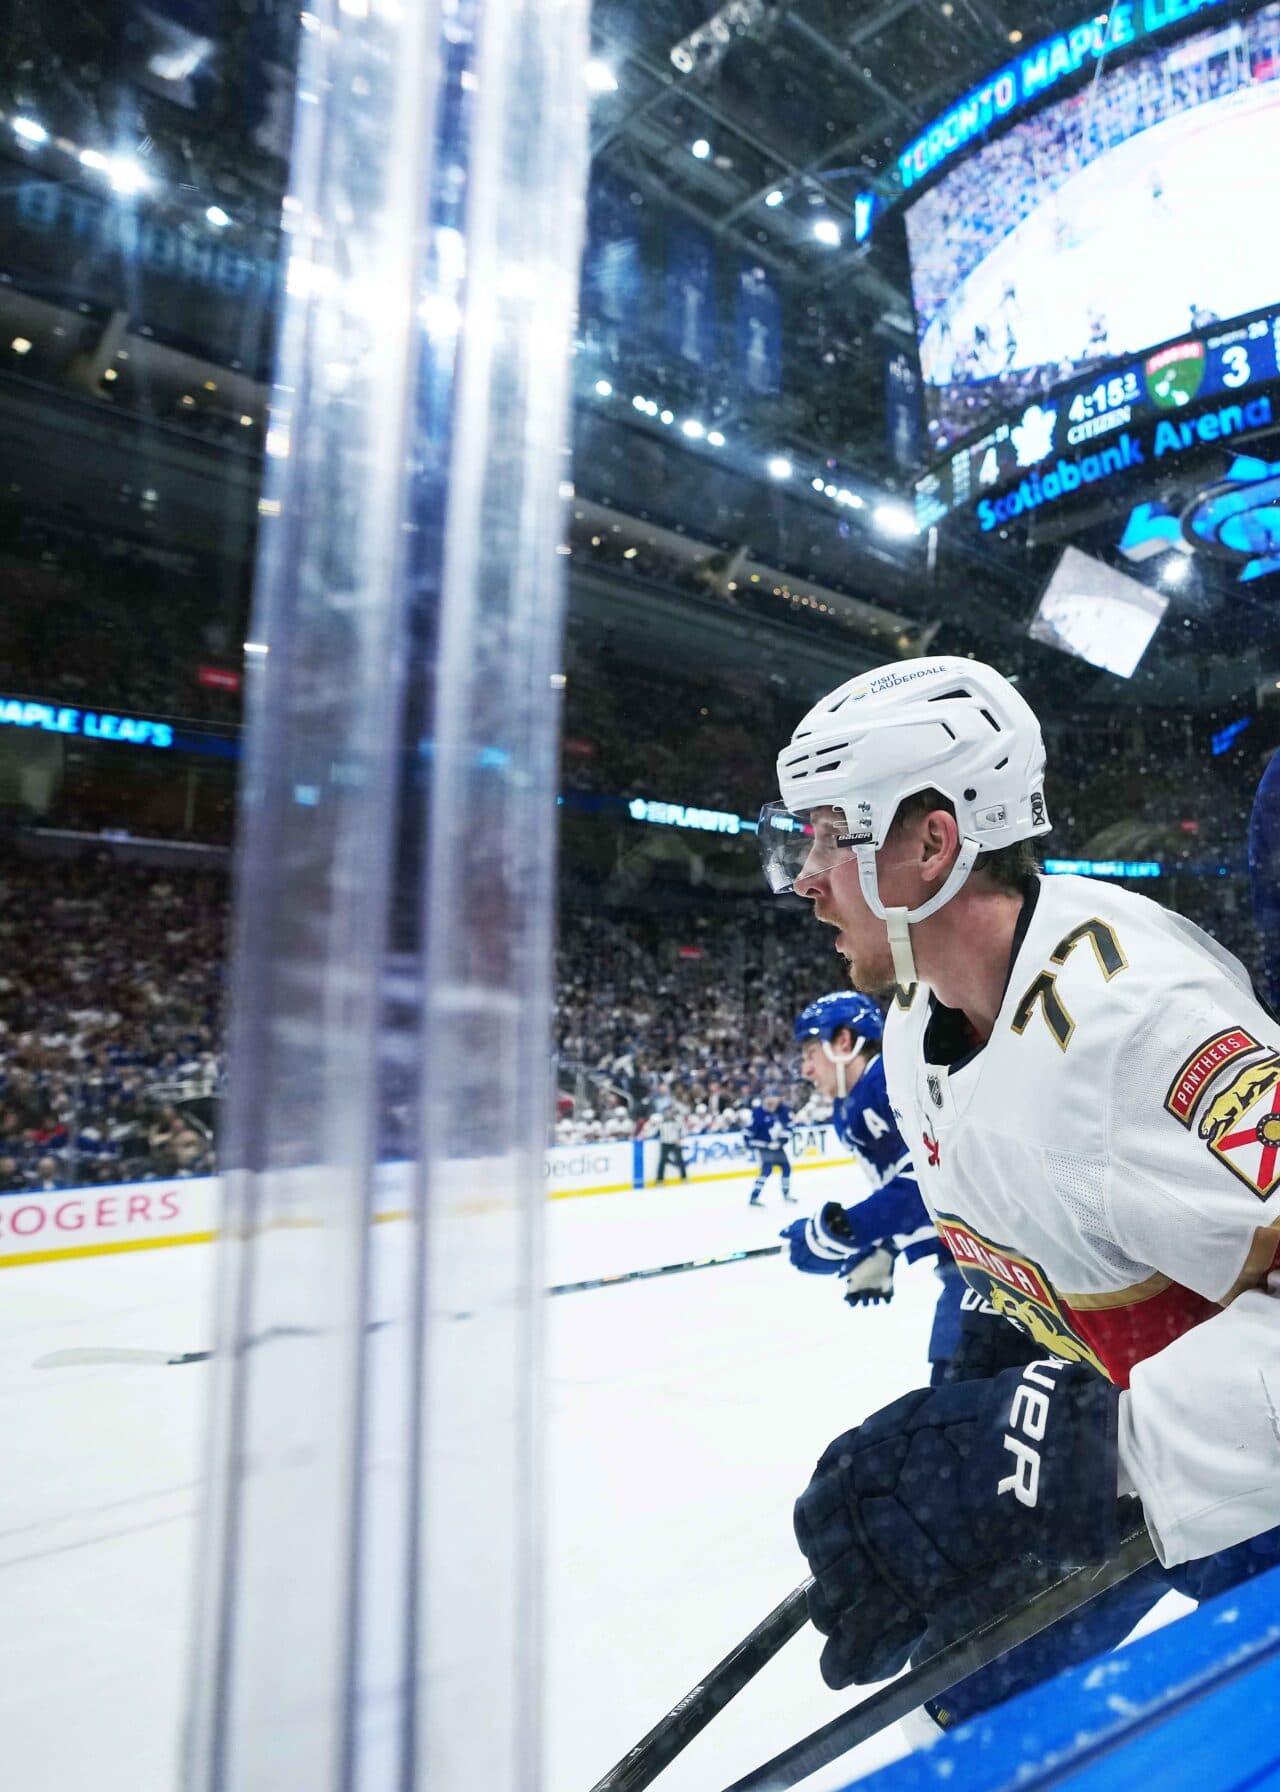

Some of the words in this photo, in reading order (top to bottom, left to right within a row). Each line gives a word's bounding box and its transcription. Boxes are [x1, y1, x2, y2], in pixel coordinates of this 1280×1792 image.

[899, 71, 1016, 188] TORONTO
[1021, 2, 1135, 97] MAPLE
[1222, 346, 1250, 388] 3
[1069, 380, 1125, 421] 4:15
[1067, 405, 1132, 445] CITIZEN
[977, 432, 1144, 532] Scotiabank
[1154, 397, 1273, 456] Arena
[979, 447, 999, 485] 4
[870, 672, 897, 687] VISIT
[870, 664, 946, 695] LAUDERDALE
[83, 712, 173, 748] LEAFS
[1011, 916, 1128, 1053] 77
[1176, 1036, 1242, 1106] PANTHERS
[792, 1129, 827, 1157] CAT
[861, 1106, 892, 1141] A
[0, 1190, 181, 1239] OGERS
